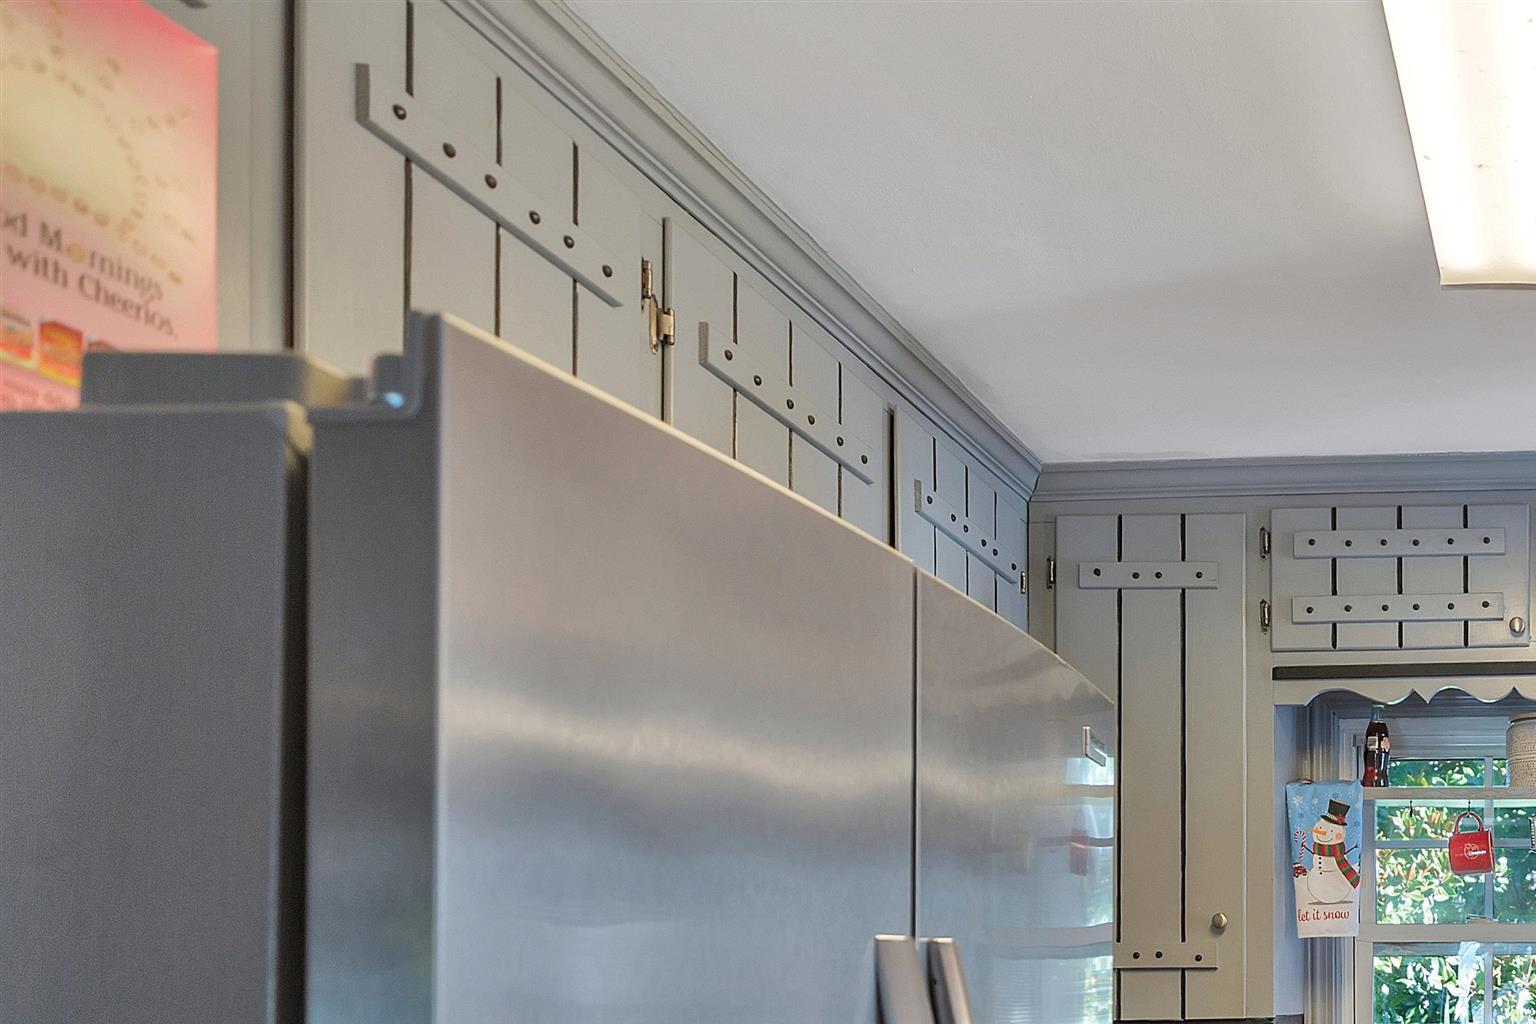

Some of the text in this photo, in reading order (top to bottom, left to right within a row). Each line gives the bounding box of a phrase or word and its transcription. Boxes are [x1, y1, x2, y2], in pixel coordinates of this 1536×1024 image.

[7, 244, 68, 288] with
[1298, 908, 1350, 921] let it snow
